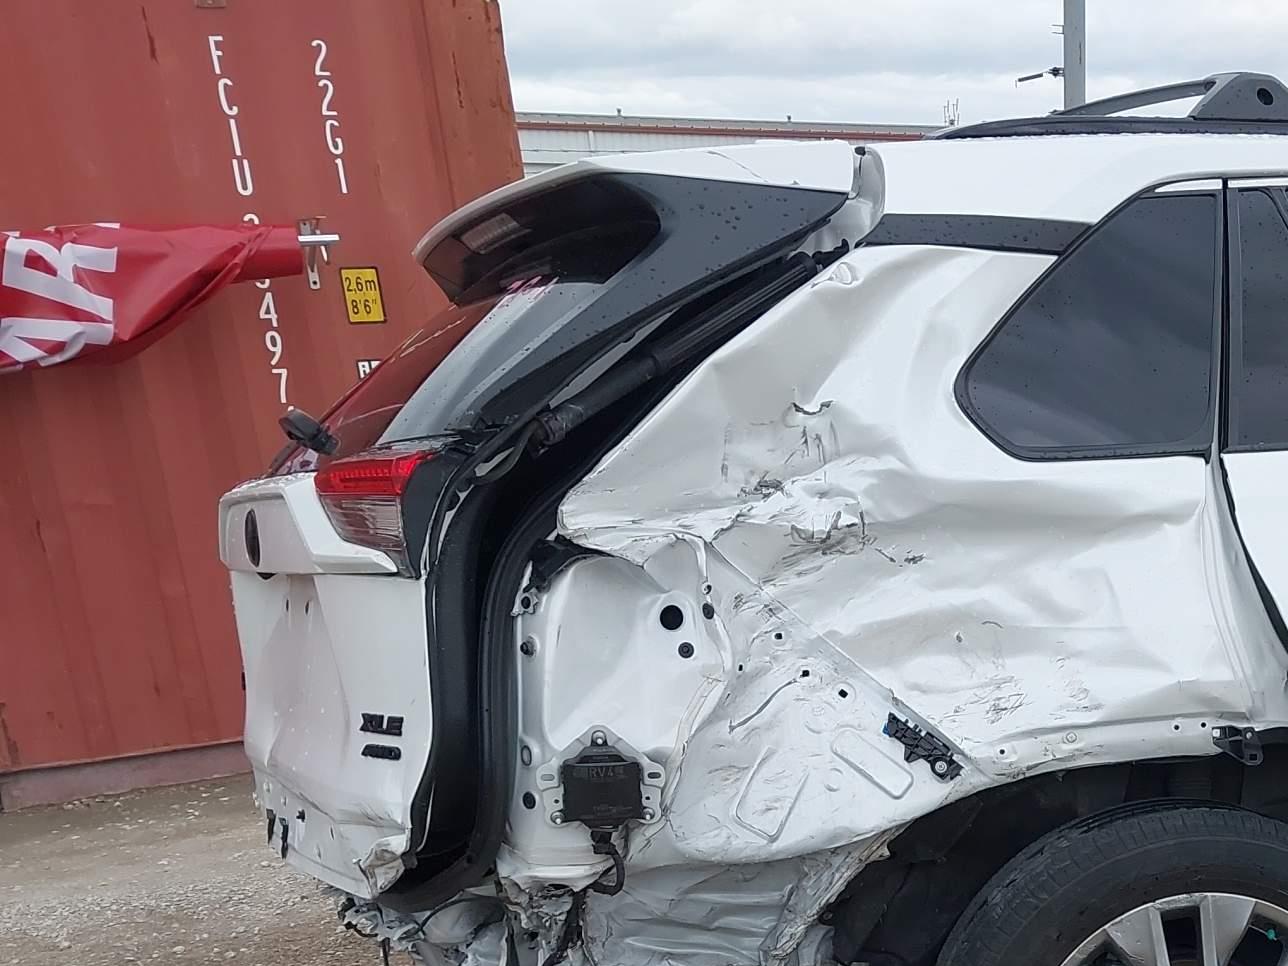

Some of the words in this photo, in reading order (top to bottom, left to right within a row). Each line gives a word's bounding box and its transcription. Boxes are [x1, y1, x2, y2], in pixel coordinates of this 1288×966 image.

[208, 35, 254, 196] FCIU
[311, 39, 348, 194] 22G1
[360, 713, 404, 737] XLE
